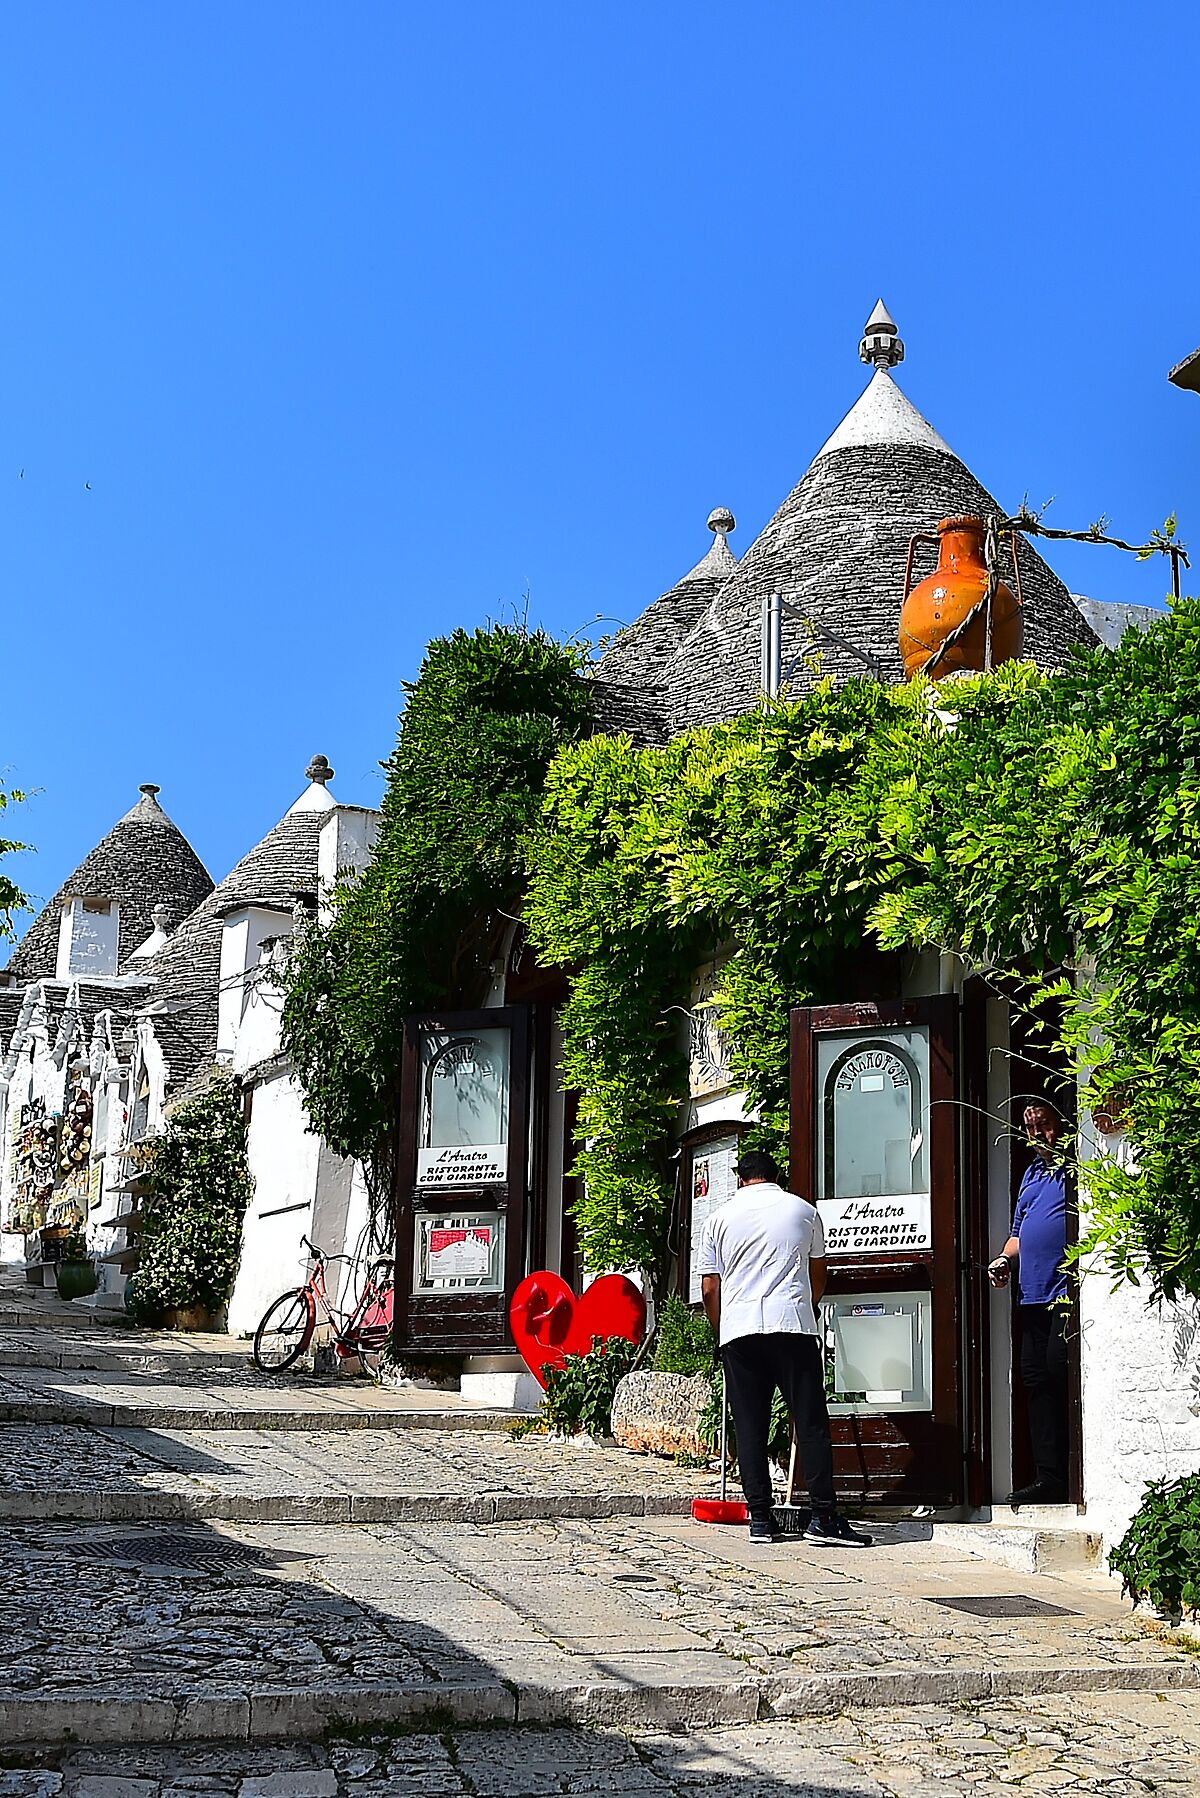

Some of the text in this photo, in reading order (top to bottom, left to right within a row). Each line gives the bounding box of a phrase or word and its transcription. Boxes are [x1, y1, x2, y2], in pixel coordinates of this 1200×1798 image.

[435, 1149, 488, 1163] L'Aratro
[426, 1164, 498, 1175] RISTORANTE
[419, 1174, 443, 1182] CON
[839, 1202, 904, 1220] L'Aratro
[828, 1223, 918, 1238] RISTORANTE
[853, 1234, 927, 1247] GIARDINO
